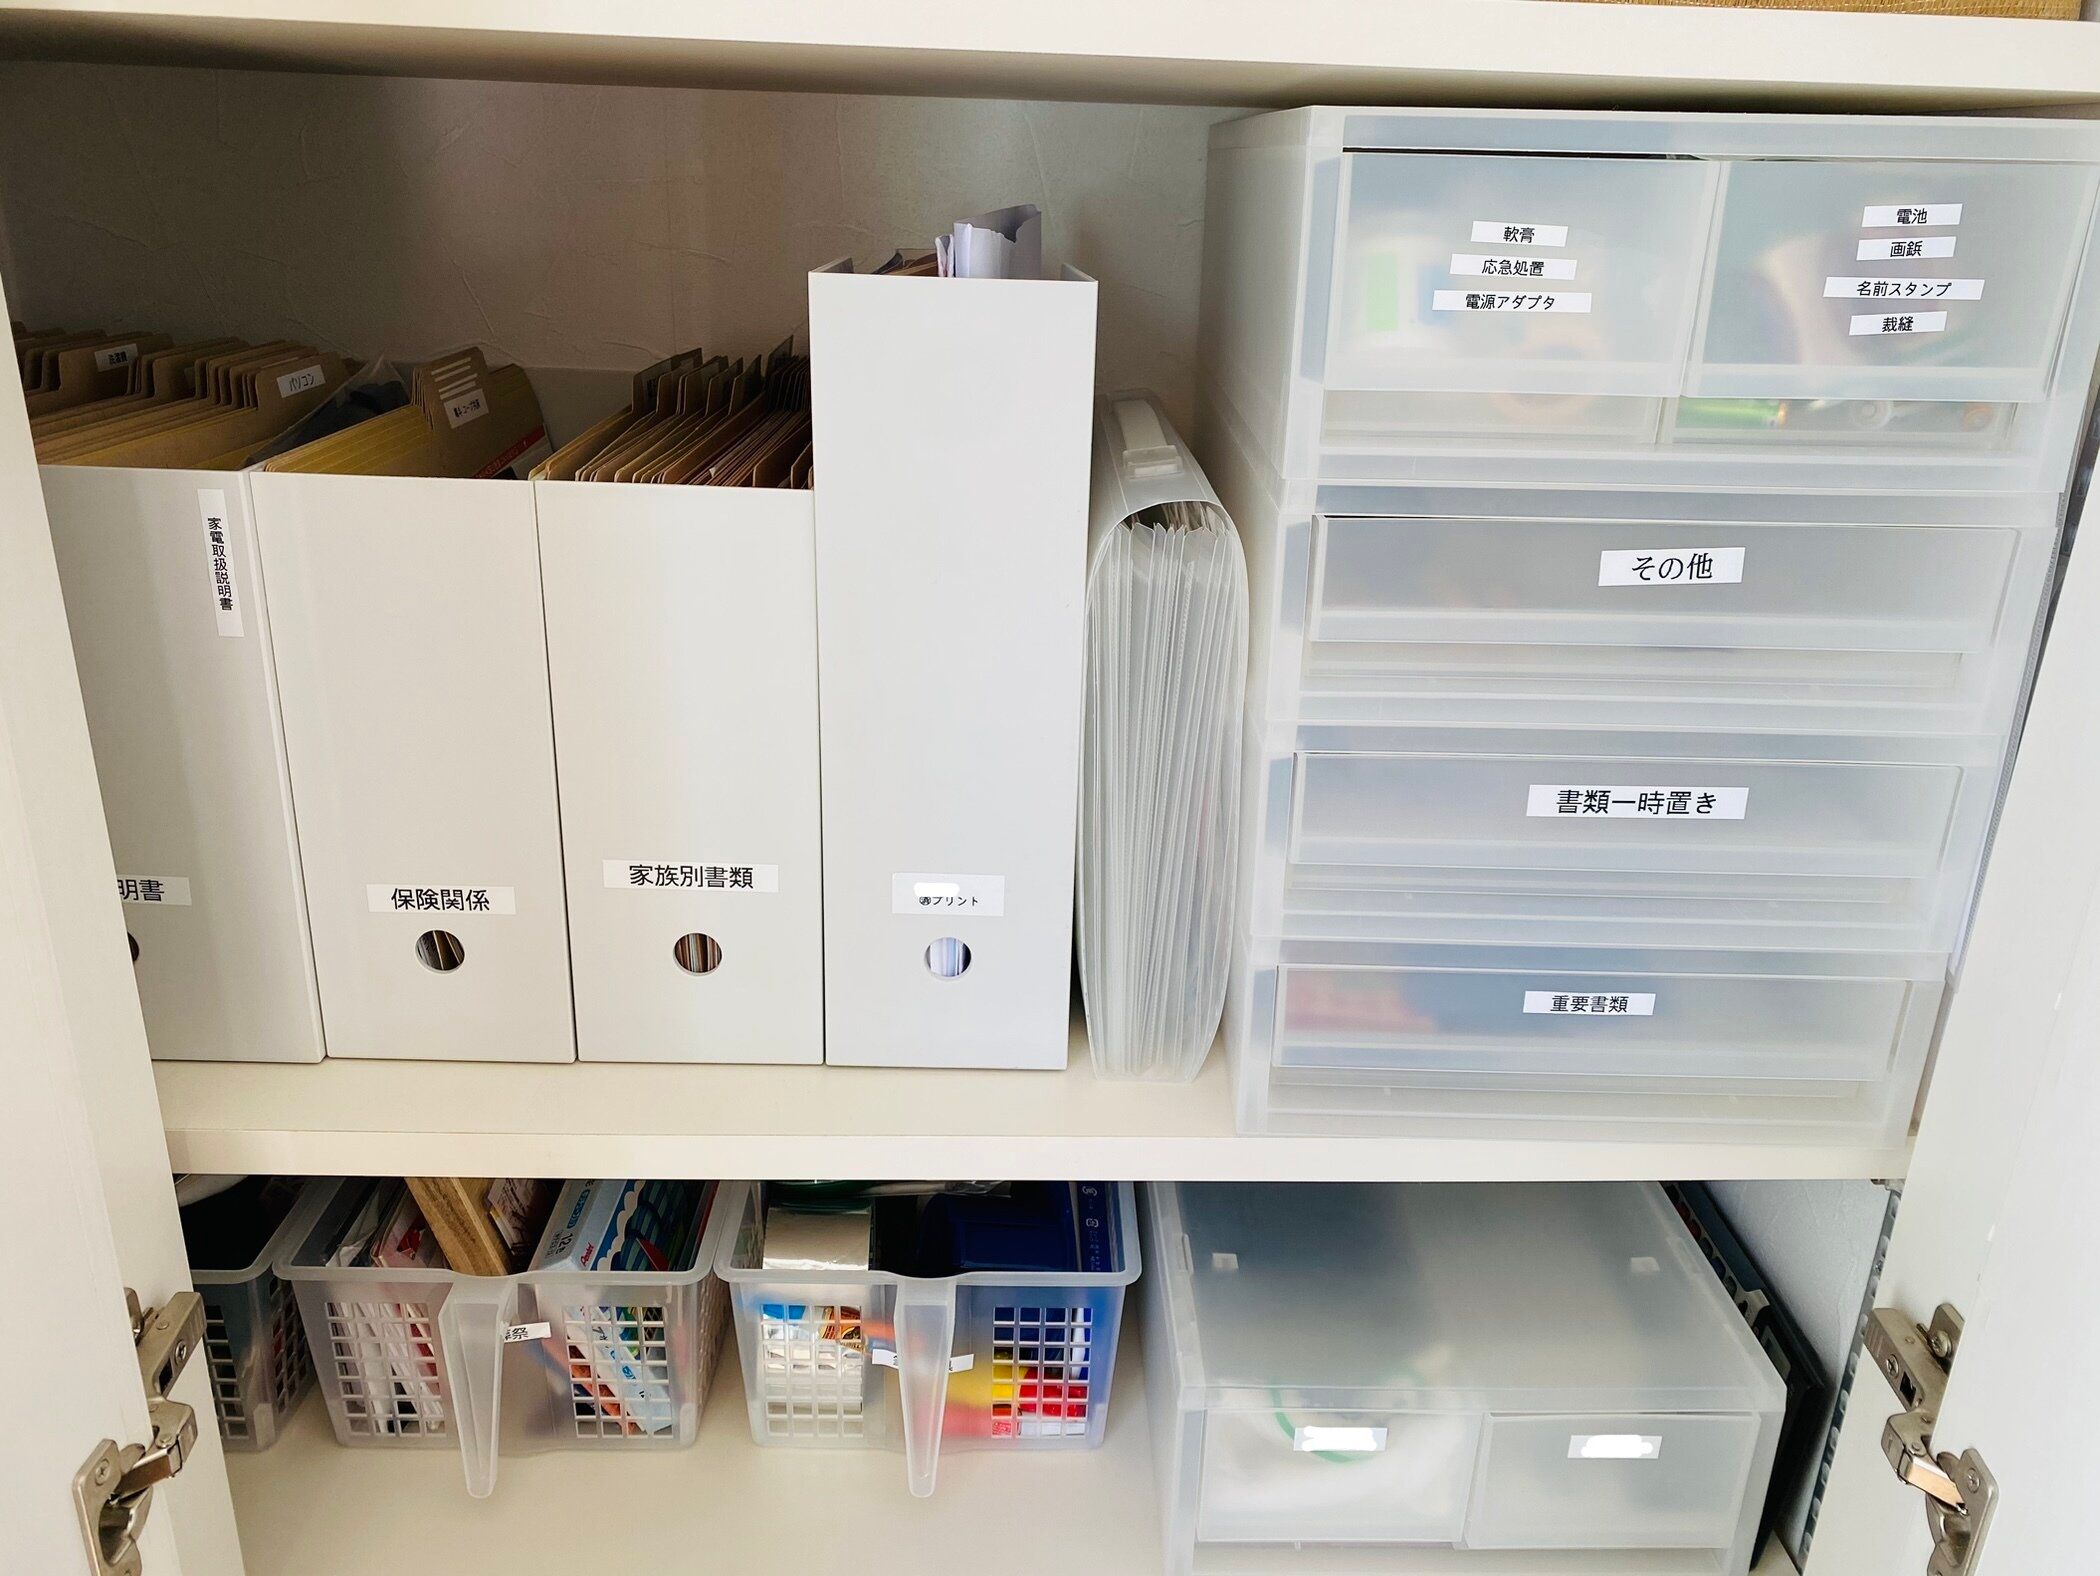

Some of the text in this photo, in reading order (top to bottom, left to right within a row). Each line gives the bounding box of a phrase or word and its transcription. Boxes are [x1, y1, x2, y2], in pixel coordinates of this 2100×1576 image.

[1896, 208, 1928, 225] 電池
[1503, 226, 1536, 244] 軟膏
[1890, 240, 1923, 258] 画鋲
[1481, 258, 1545, 277] 応急処置
[1856, 280, 1953, 297] 名前スタンプ
[1465, 293, 1555, 310] 電源アダプタ
[1882, 315, 1914, 333] 裁縫
[288, 373, 316, 392] パソコン
[207, 517, 234, 611] 家電取扱説明書
[1632, 552, 1714, 581] その他
[1556, 789, 1717, 815] 書類一時置き
[629, 864, 754, 890] 家族別書類
[117, 879, 165, 902] 明書
[391, 887, 490, 912] 保険関係
[1550, 994, 1630, 1013] 重要書類
